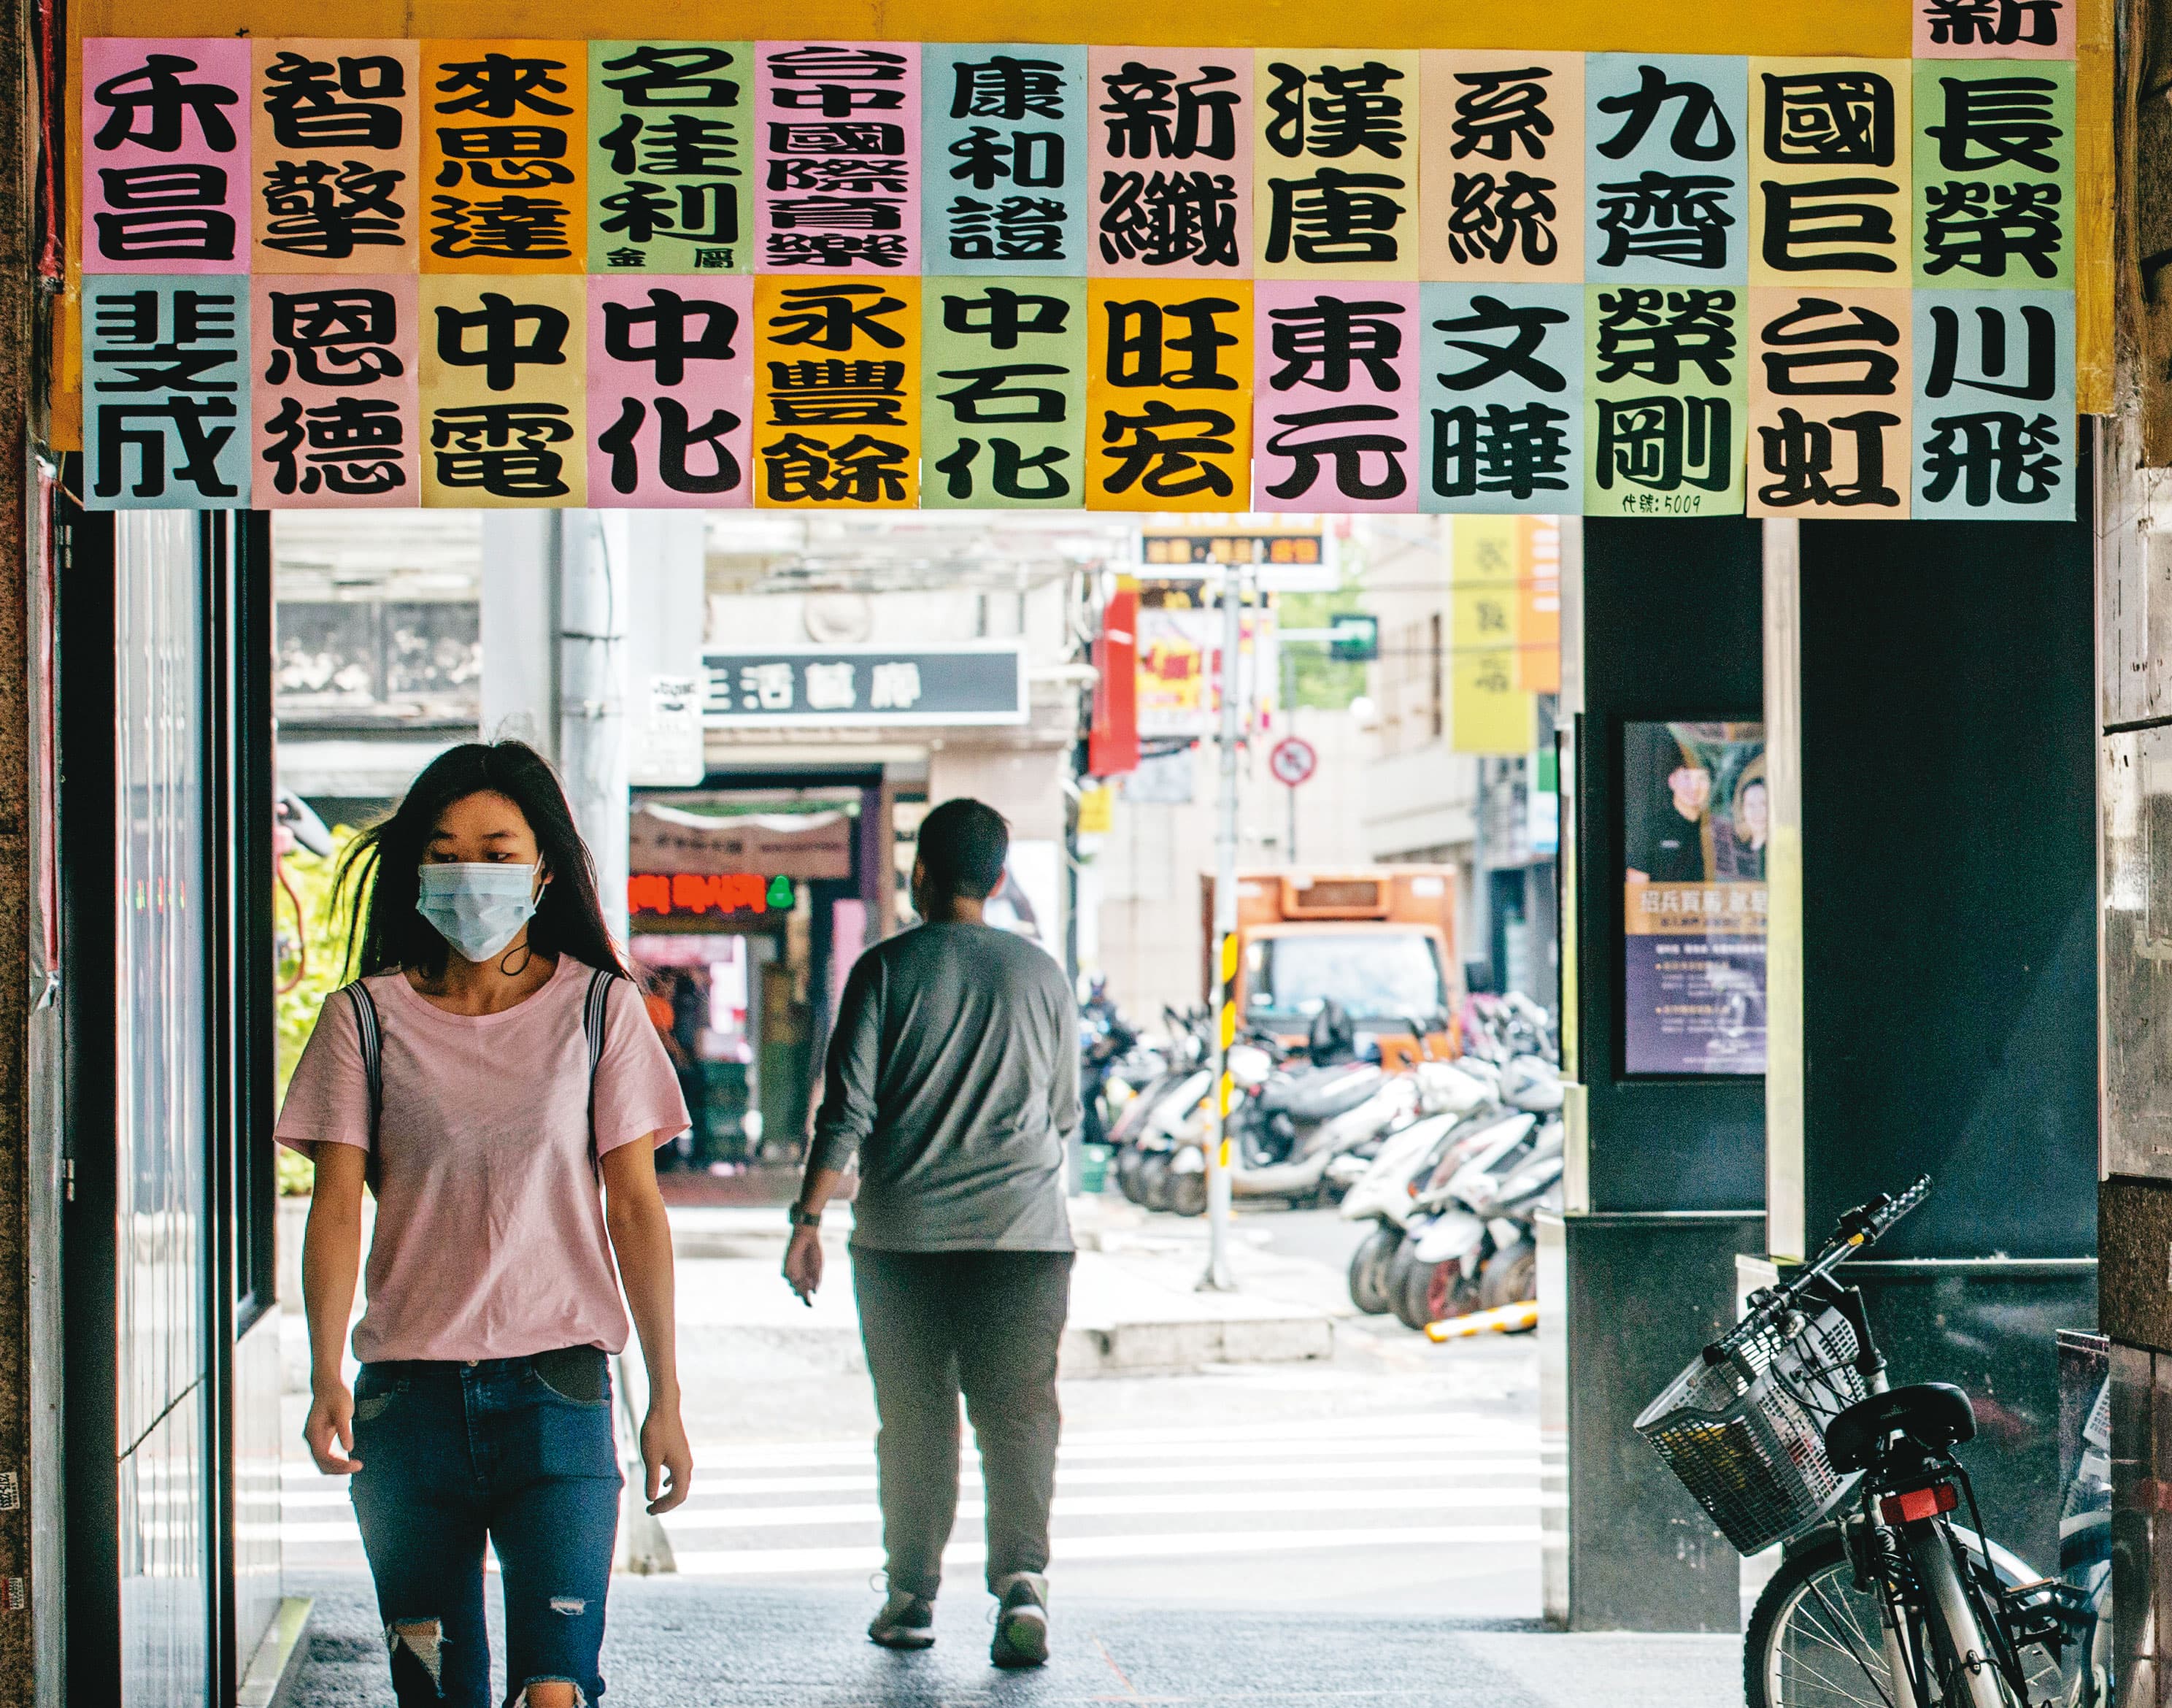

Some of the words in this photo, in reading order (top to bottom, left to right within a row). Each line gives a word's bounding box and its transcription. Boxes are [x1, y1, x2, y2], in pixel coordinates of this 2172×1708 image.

[94, 55, 238, 260] 禾昌
[262, 52, 405, 258] 智擎
[431, 54, 574, 258] 來思達
[599, 48, 742, 243] 名佳利
[767, 50, 907, 266] 台中國際育樂
[947, 56, 1067, 260] 康和證
[1100, 62, 1241, 266] 新纖
[1266, 62, 1406, 263] 漢唐
[1449, 67, 1557, 265] 系統
[1597, 66, 1735, 269] 九齊
[1761, 72, 1899, 272] 國巨
[1923, 77, 2063, 278] 長榮
[606, 247, 733, 268] 金屬
[263, 289, 405, 494] 恩德
[431, 293, 573, 497] 中電
[598, 289, 740, 493] 中化
[762, 285, 909, 501] 永豐餘
[936, 288, 1069, 499] 中石化
[1103, 298, 1239, 496] 旺宏
[1266, 296, 1406, 499] 東元
[1431, 296, 1571, 499] 文曄
[1596, 289, 1736, 491] 榮剛
[1758, 298, 1900, 506] 台虹
[1922, 306, 2062, 506] 川飛
